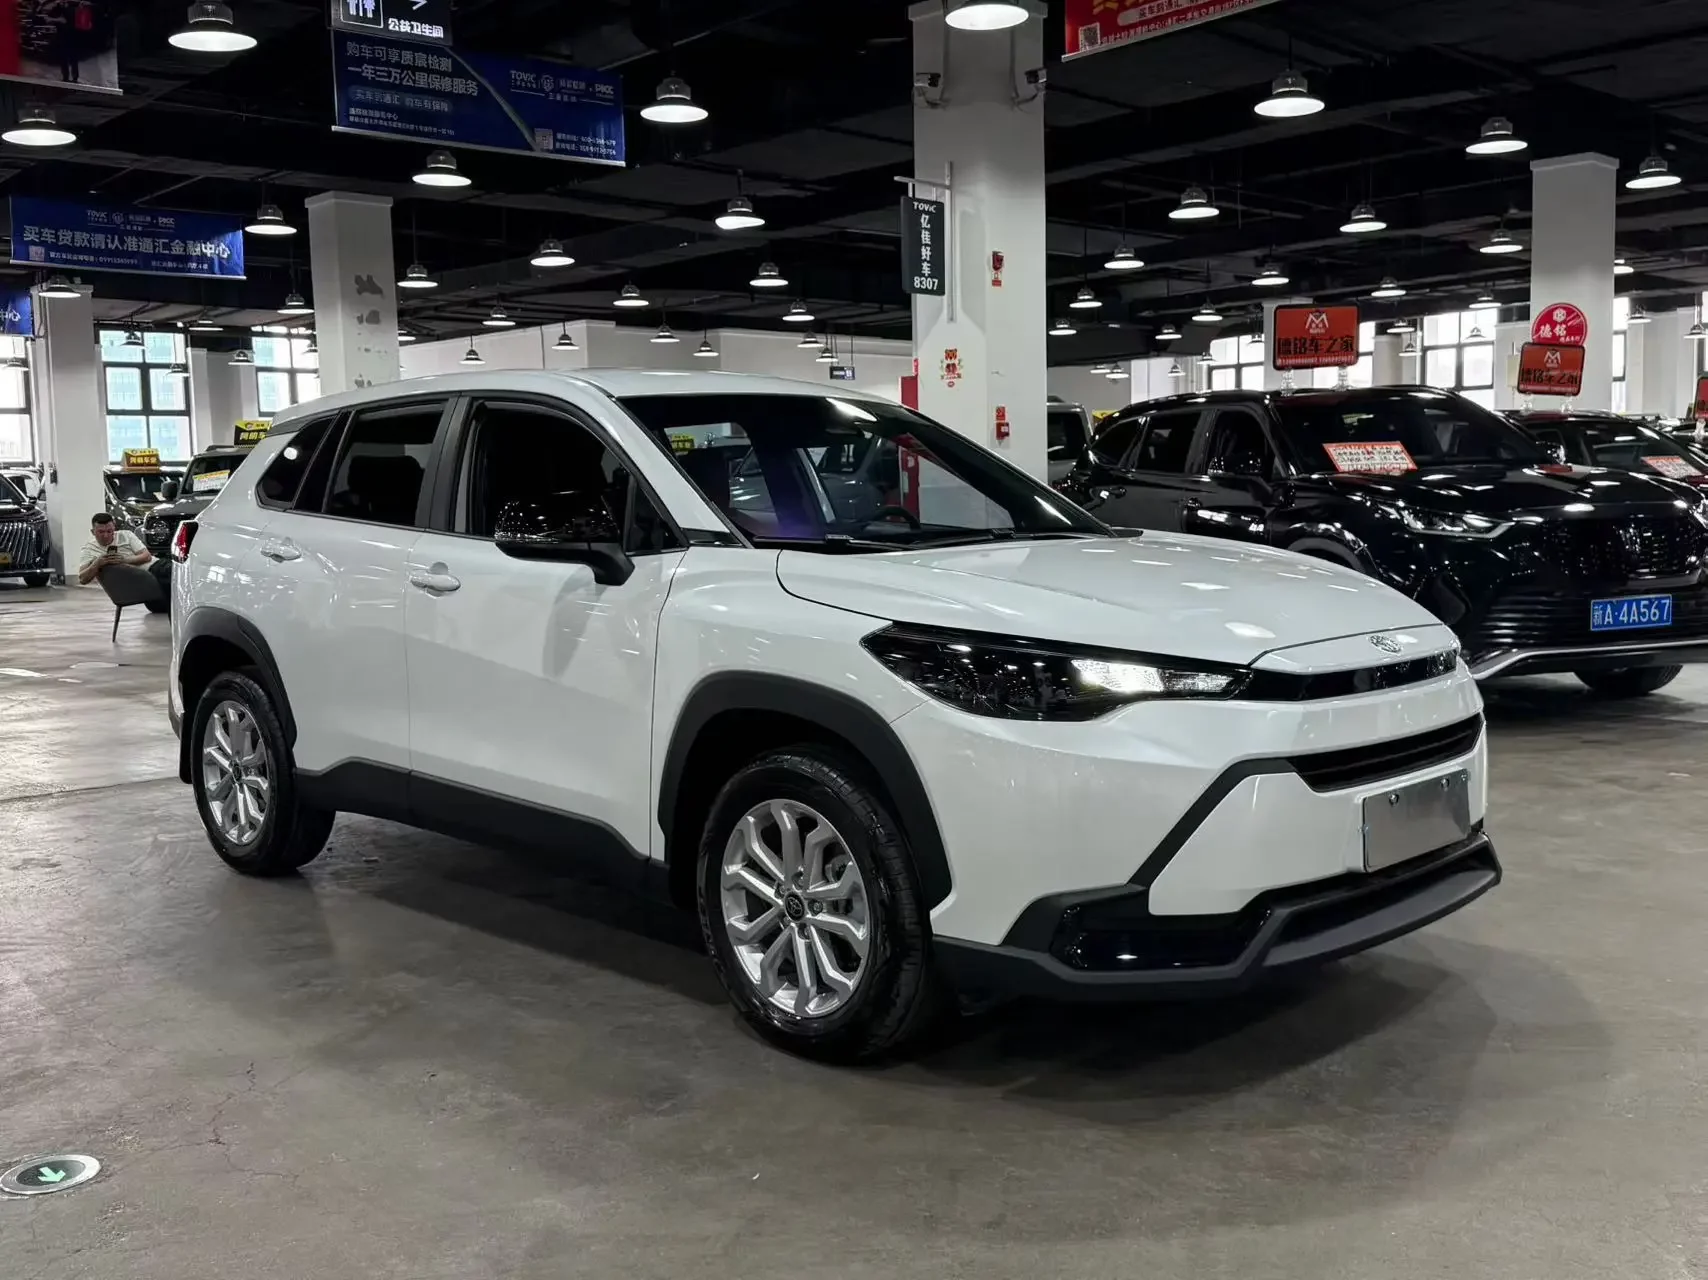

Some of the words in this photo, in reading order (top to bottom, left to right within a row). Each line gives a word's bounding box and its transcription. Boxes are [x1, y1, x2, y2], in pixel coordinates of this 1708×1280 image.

[388, 17, 444, 39] 公共卫生间
[347, 63, 479, 97] 一年三万公里保修服务
[23, 225, 231, 260] 买车贷款请认准通汇金融中心
[920, 213, 932, 277] 亿佳好车
[913, 276, 939, 291] 8307
